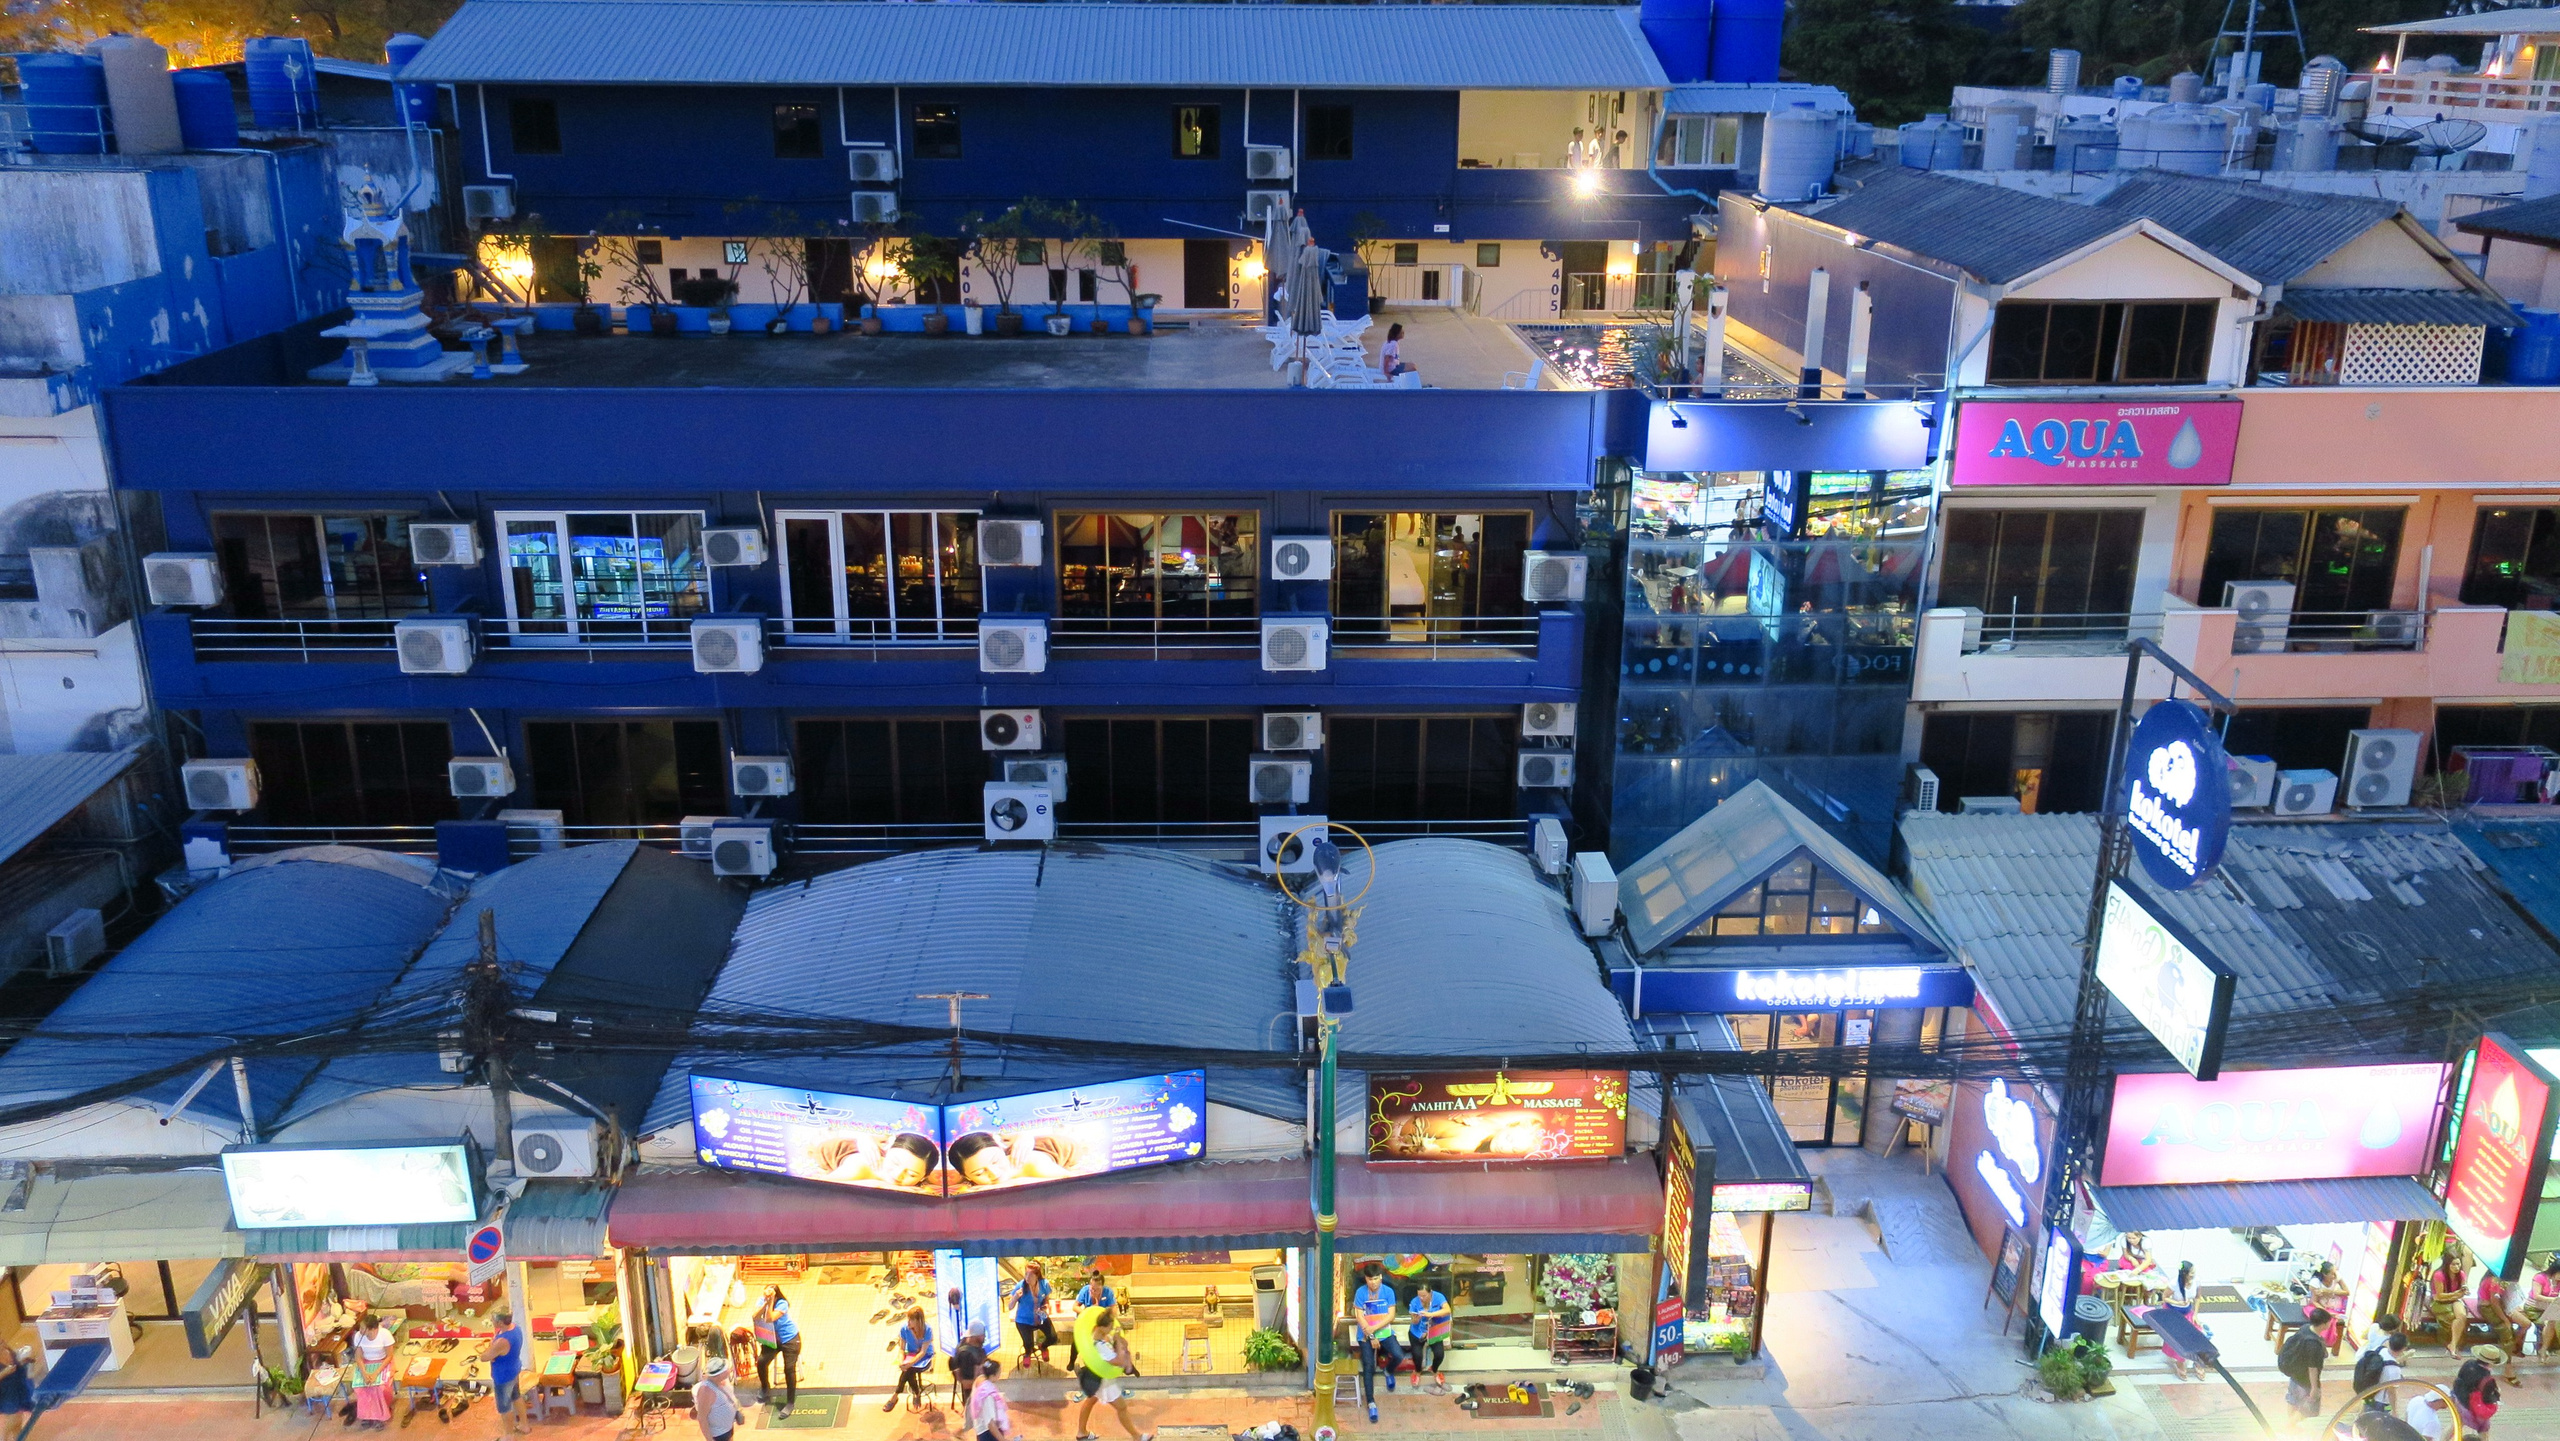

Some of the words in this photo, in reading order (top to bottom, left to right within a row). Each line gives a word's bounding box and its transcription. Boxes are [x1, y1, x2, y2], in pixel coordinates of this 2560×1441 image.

[1550, 268, 1560, 312] 405
[1988, 418, 2144, 467] AQUA
[2067, 459, 2139, 469] MASSAGE
[2130, 780, 2200, 863] kokotel
[1736, 970, 1859, 1001] kokotel
[738, 1108, 798, 1124] ANAHITA
[827, 1118, 892, 1135] MASSAGE
[998, 1116, 1063, 1135] ANAHITA
[1092, 1101, 1158, 1119] MASSAGE
[1410, 1097, 1477, 1112] ANAHITAA
[1523, 1098, 1582, 1108] MASSAGE
[2140, 1098, 2330, 1152] AQUA
[2474, 1100, 2528, 1160] AQUA
[1766, 1184, 1807, 1195] TOUR
[209, 1272, 242, 1320] VIVA
[214, 1288, 245, 1336] PATONG
[1658, 1302, 1682, 1315] LAUNDRY
